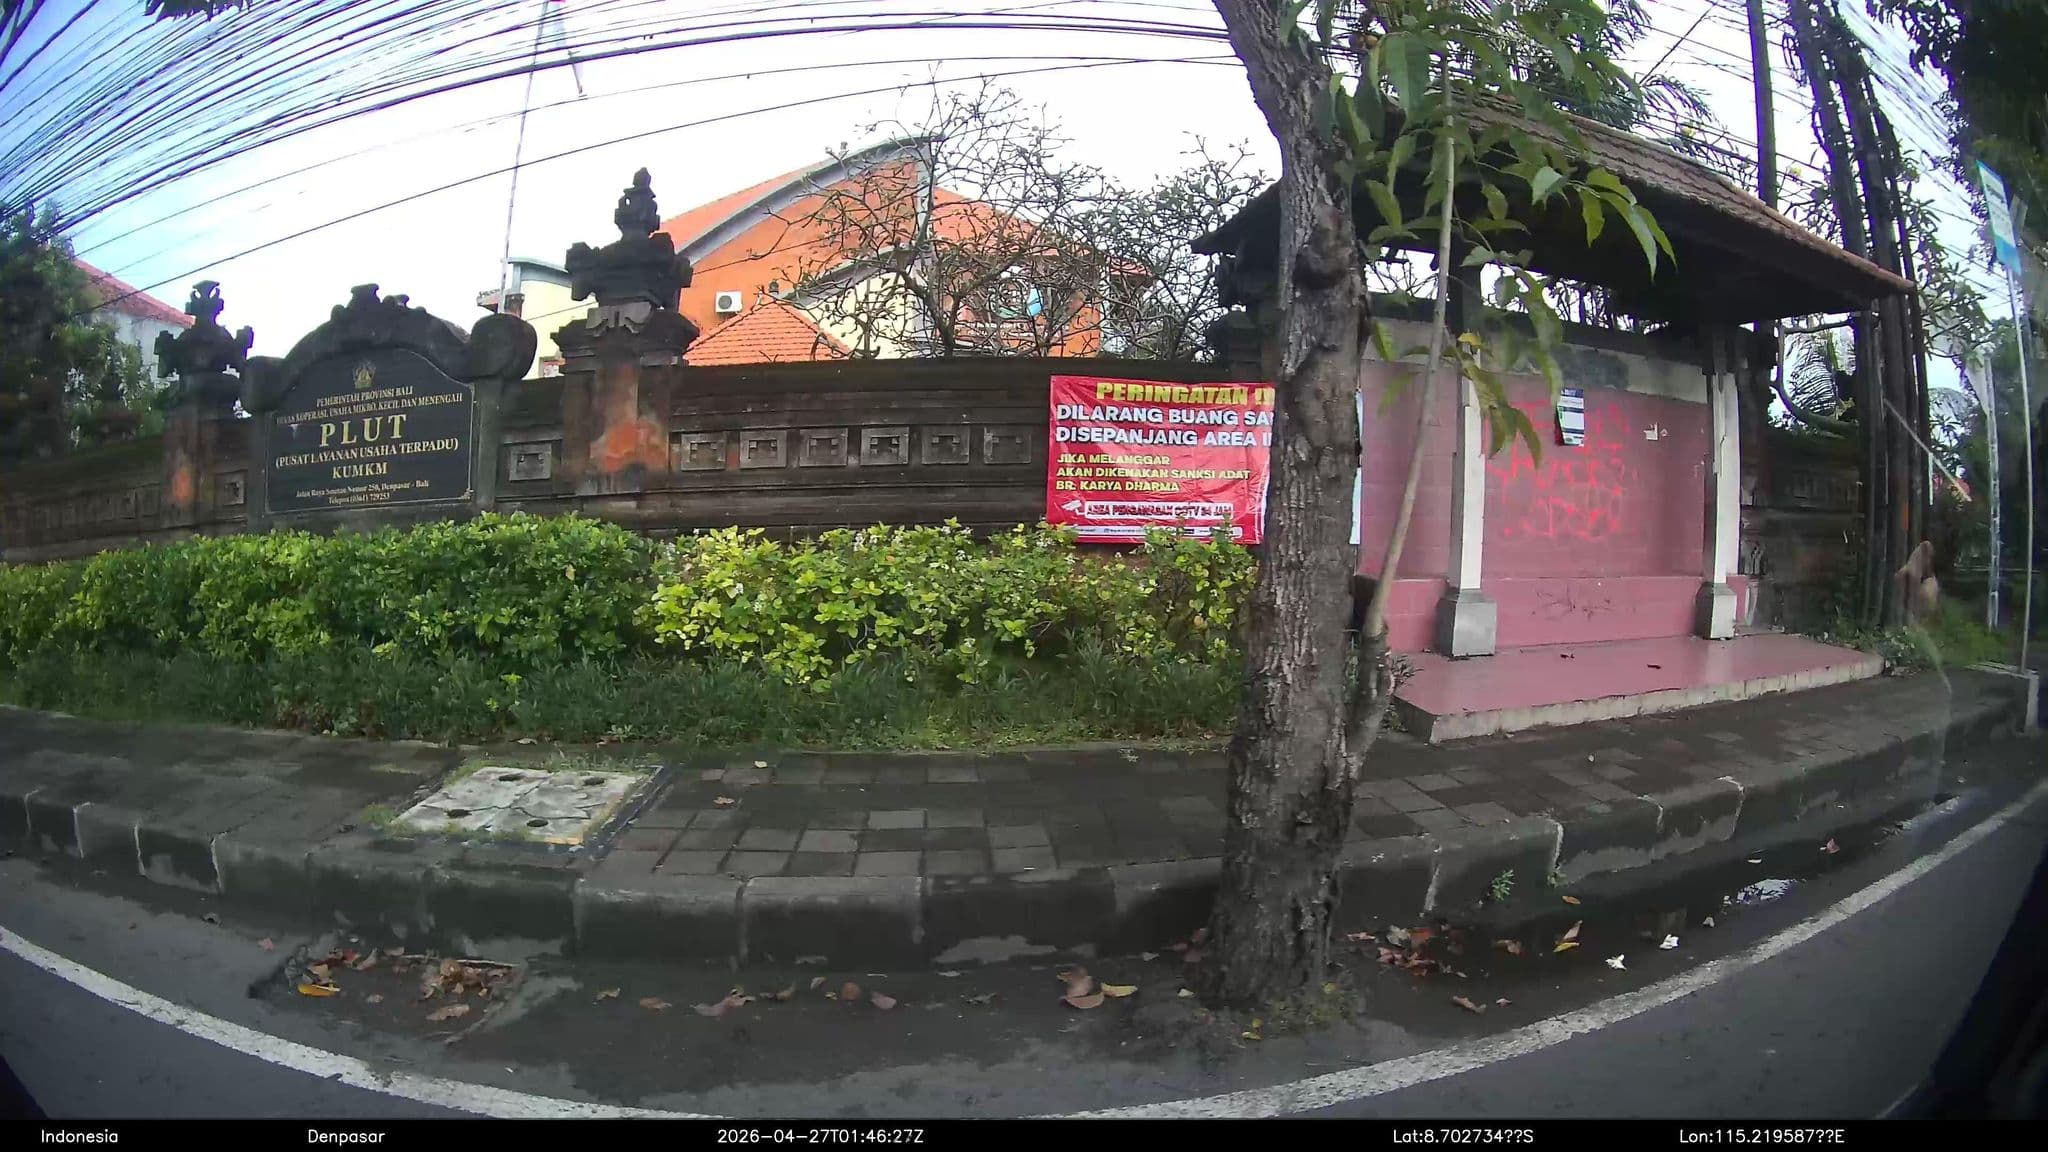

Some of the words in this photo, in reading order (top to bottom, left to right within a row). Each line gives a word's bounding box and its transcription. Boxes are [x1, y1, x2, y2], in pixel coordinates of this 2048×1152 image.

[316, 392, 360, 407] PEMERINTAH
[361, 388, 394, 401] PROVINSI
[396, 385, 413, 397] BALI
[1096, 382, 1248, 405] PERINGATAN
[330, 405, 352, 417] USAHA
[401, 397, 417, 408] DAN
[418, 393, 463, 406] MENENGAH
[1056, 404, 1163, 423] DILARANG
[1168, 408, 1239, 425] BUANG
[1244, 411, 1274, 426] SA
[320, 414, 407, 448] PLUT
[1055, 426, 1198, 445] DISEPANJANG
[1204, 431, 1257, 446] AREA
[1262, 431, 1272, 447] I
[275, 453, 310, 469] (PUSAT
[311, 447, 358, 463] LAYANAN
[360, 444, 397, 458] USAHA
[399, 437, 459, 454] TERPADU)
[1057, 454, 1086, 464] JIKA
[1089, 454, 1170, 465] MELANGGAR
[332, 462, 388, 479] KUMKM
[1056, 467, 1093, 477] AKAN
[1095, 467, 1169, 478] DIKENAKAN
[1171, 469, 1216, 479] SANKSI
[1219, 470, 1251, 479] ADAT
[416, 480, 429, 488] Bali
[1056, 480, 1077, 490] BR.
[1080, 481, 1122, 491] KARYA
[1125, 481, 1180, 492] DHARMA
